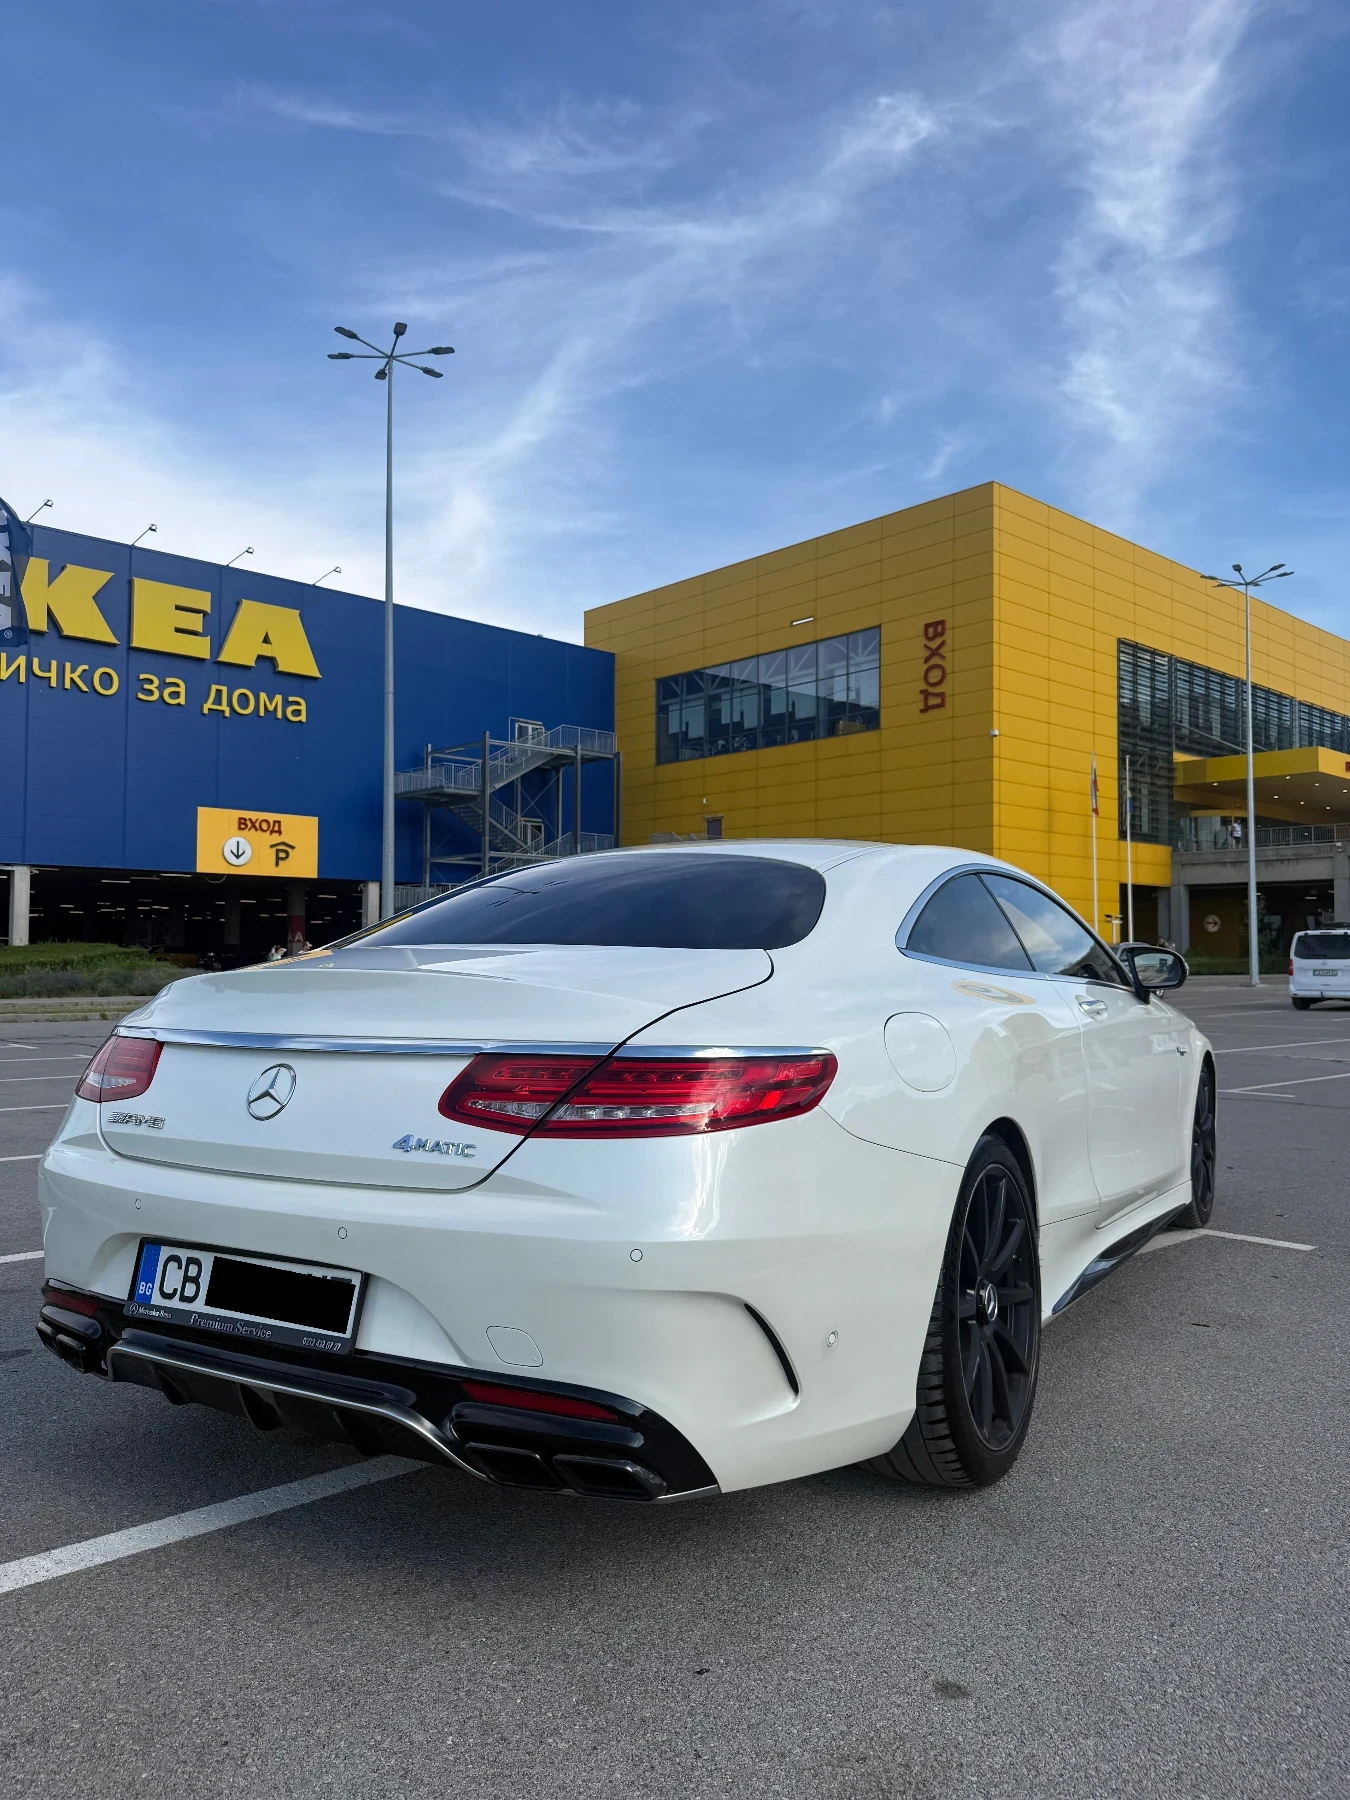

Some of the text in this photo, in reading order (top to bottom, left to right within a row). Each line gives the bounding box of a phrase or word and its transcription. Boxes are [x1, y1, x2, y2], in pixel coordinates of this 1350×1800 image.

[919, 619, 946, 713] ВХОД
[137, 673, 186, 706] за
[202, 684, 307, 723] дома
[237, 816, 283, 836] ВХОД
[275, 848, 290, 868] P
[392, 1133, 477, 1158] 4MATIC
[139, 1282, 153, 1296] BG
[159, 1254, 203, 1304] CB
[189, 1313, 272, 1339] Premium Service
